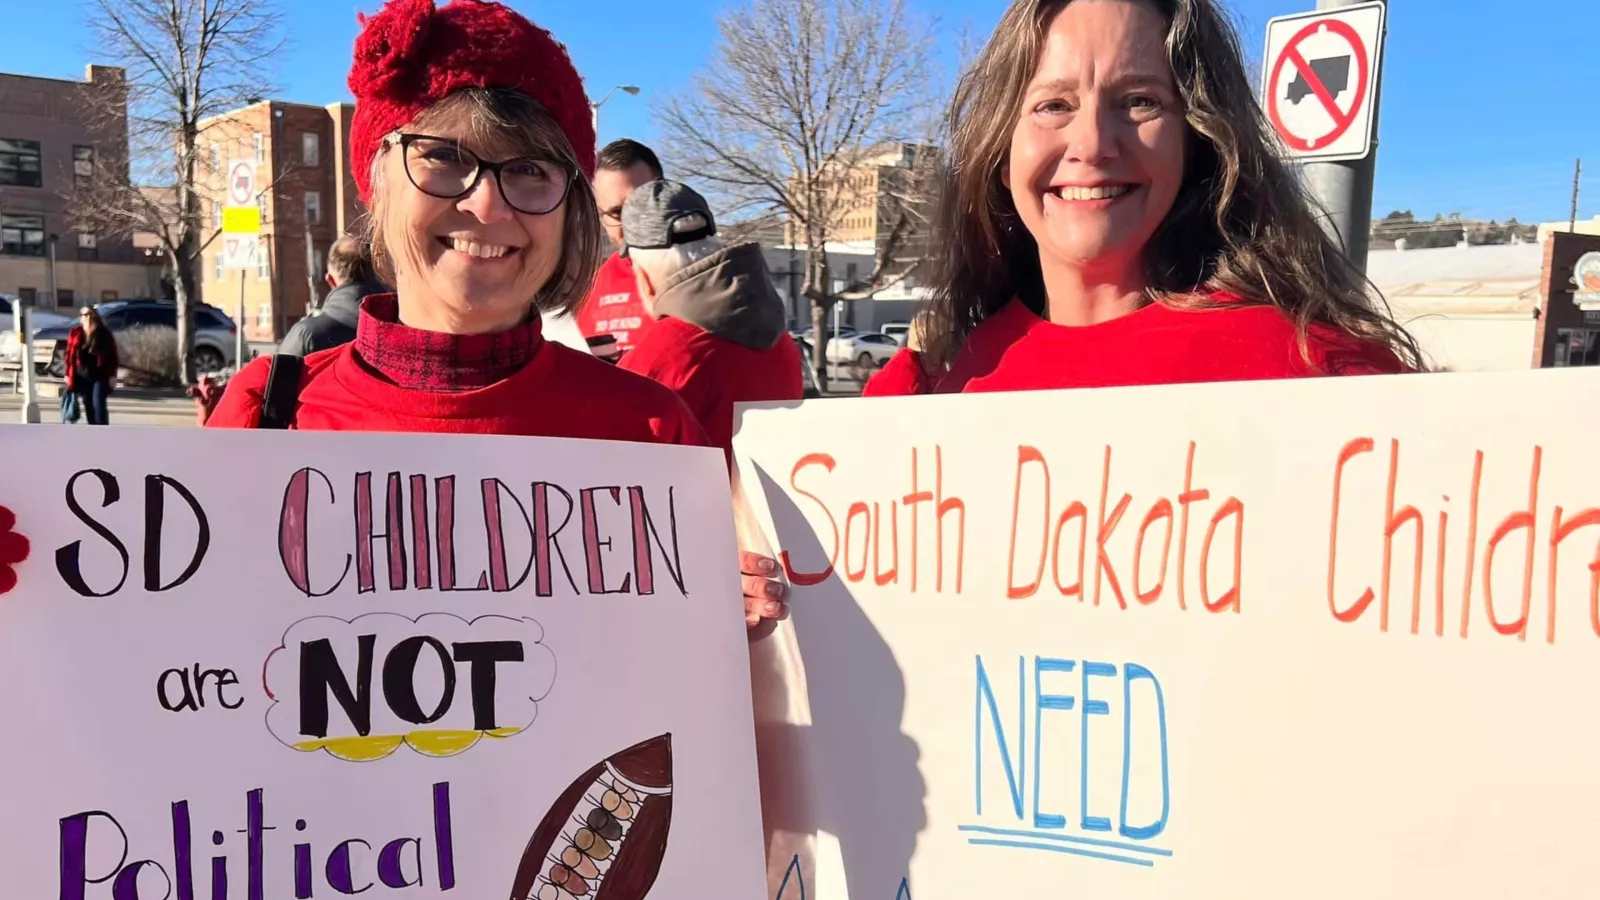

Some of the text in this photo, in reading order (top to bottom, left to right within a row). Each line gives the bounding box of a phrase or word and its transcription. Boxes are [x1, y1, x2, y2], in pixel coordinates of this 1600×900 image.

[55, 467, 689, 597] SD CHILDREN
[779, 445, 966, 594] South
[1007, 441, 1244, 614] Dakota
[157, 635, 524, 737] are NOT
[974, 655, 1171, 839] NEED
[60, 781, 456, 900] Political
